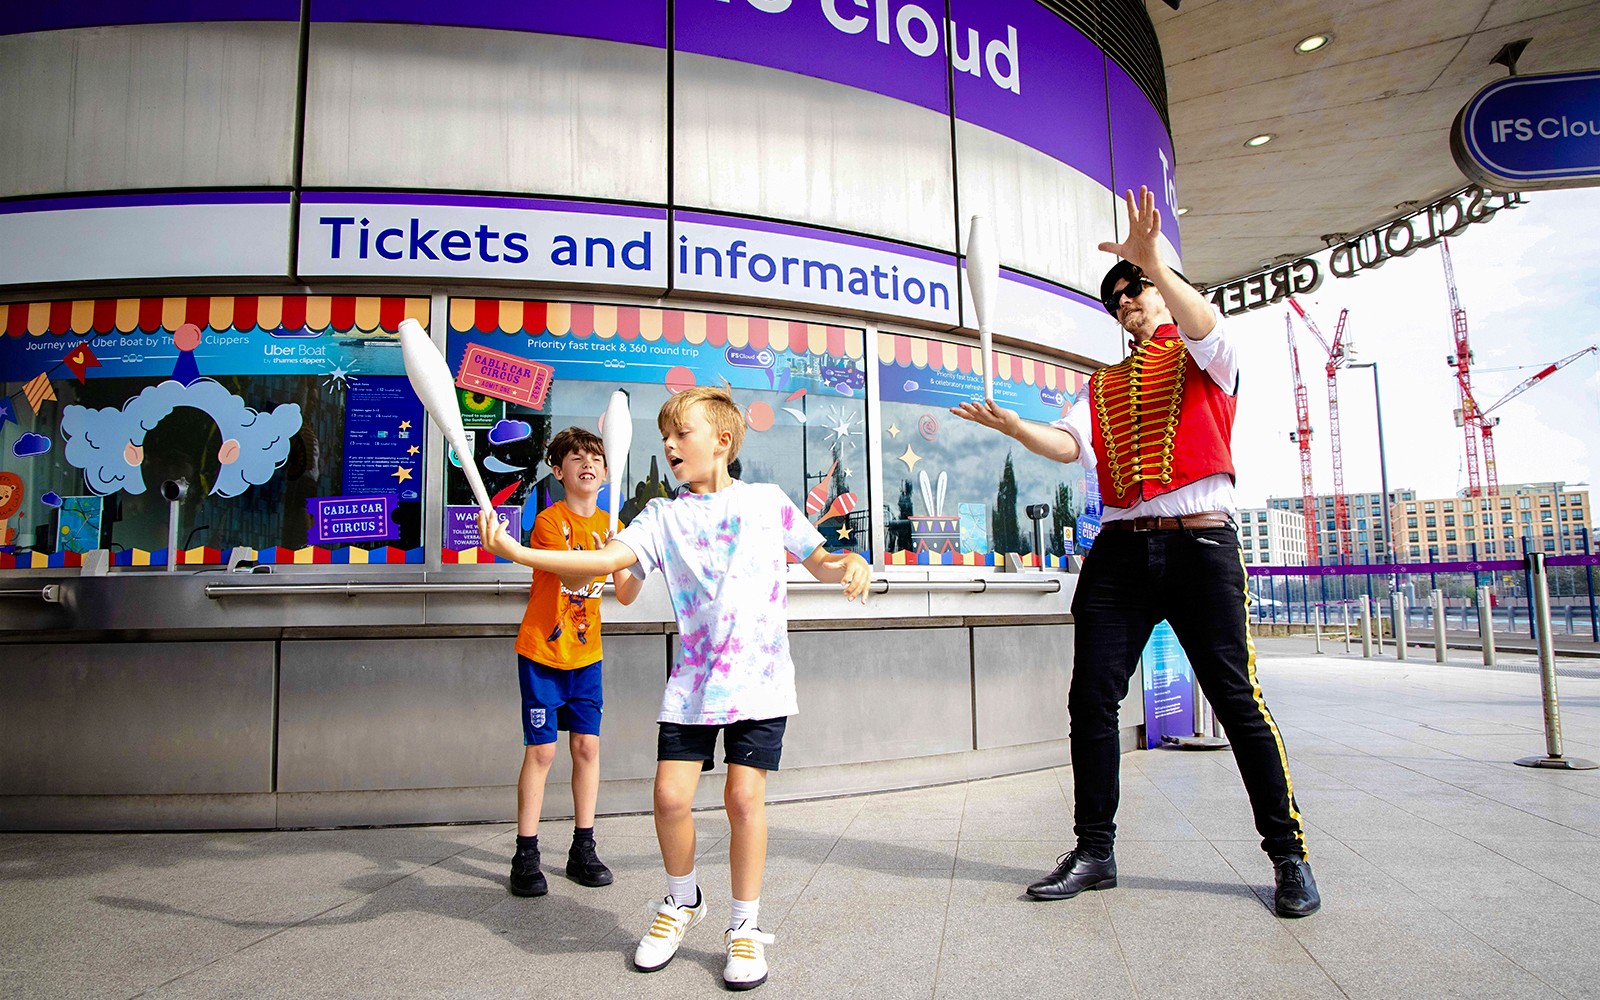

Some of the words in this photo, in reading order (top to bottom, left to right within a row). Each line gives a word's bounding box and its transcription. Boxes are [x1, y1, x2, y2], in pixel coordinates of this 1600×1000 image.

[1491, 118, 1533, 143] IFS
[1537, 115, 1600, 139] Clou
[319, 216, 529, 264] Tickets
[551, 231, 652, 271] and
[679, 234, 950, 311] information
[26, 341, 65, 351] Journey
[92, 338, 117, 348] Uber
[120, 337, 143, 347] Boat
[146, 337, 159, 347] by
[205, 335, 249, 346] Clippers
[264, 344, 295, 356] Uber
[298, 344, 326, 356] Boat
[527, 339, 566, 351] Priority
[569, 341, 589, 350] fast
[591, 342, 617, 352] track
[619, 343, 627, 352] &
[629, 343, 647, 353] 360
[650, 345, 680, 355] round
[681, 347, 700, 358] trip
[474, 354, 508, 371] CABLE
[510, 365, 531, 378] CAR
[481, 366, 520, 384] CIRCUS
[481, 381, 499, 391] ADMIT
[324, 504, 358, 515] CABLE
[361, 503, 383, 513] CAR
[332, 521, 376, 533] CIRCUS
